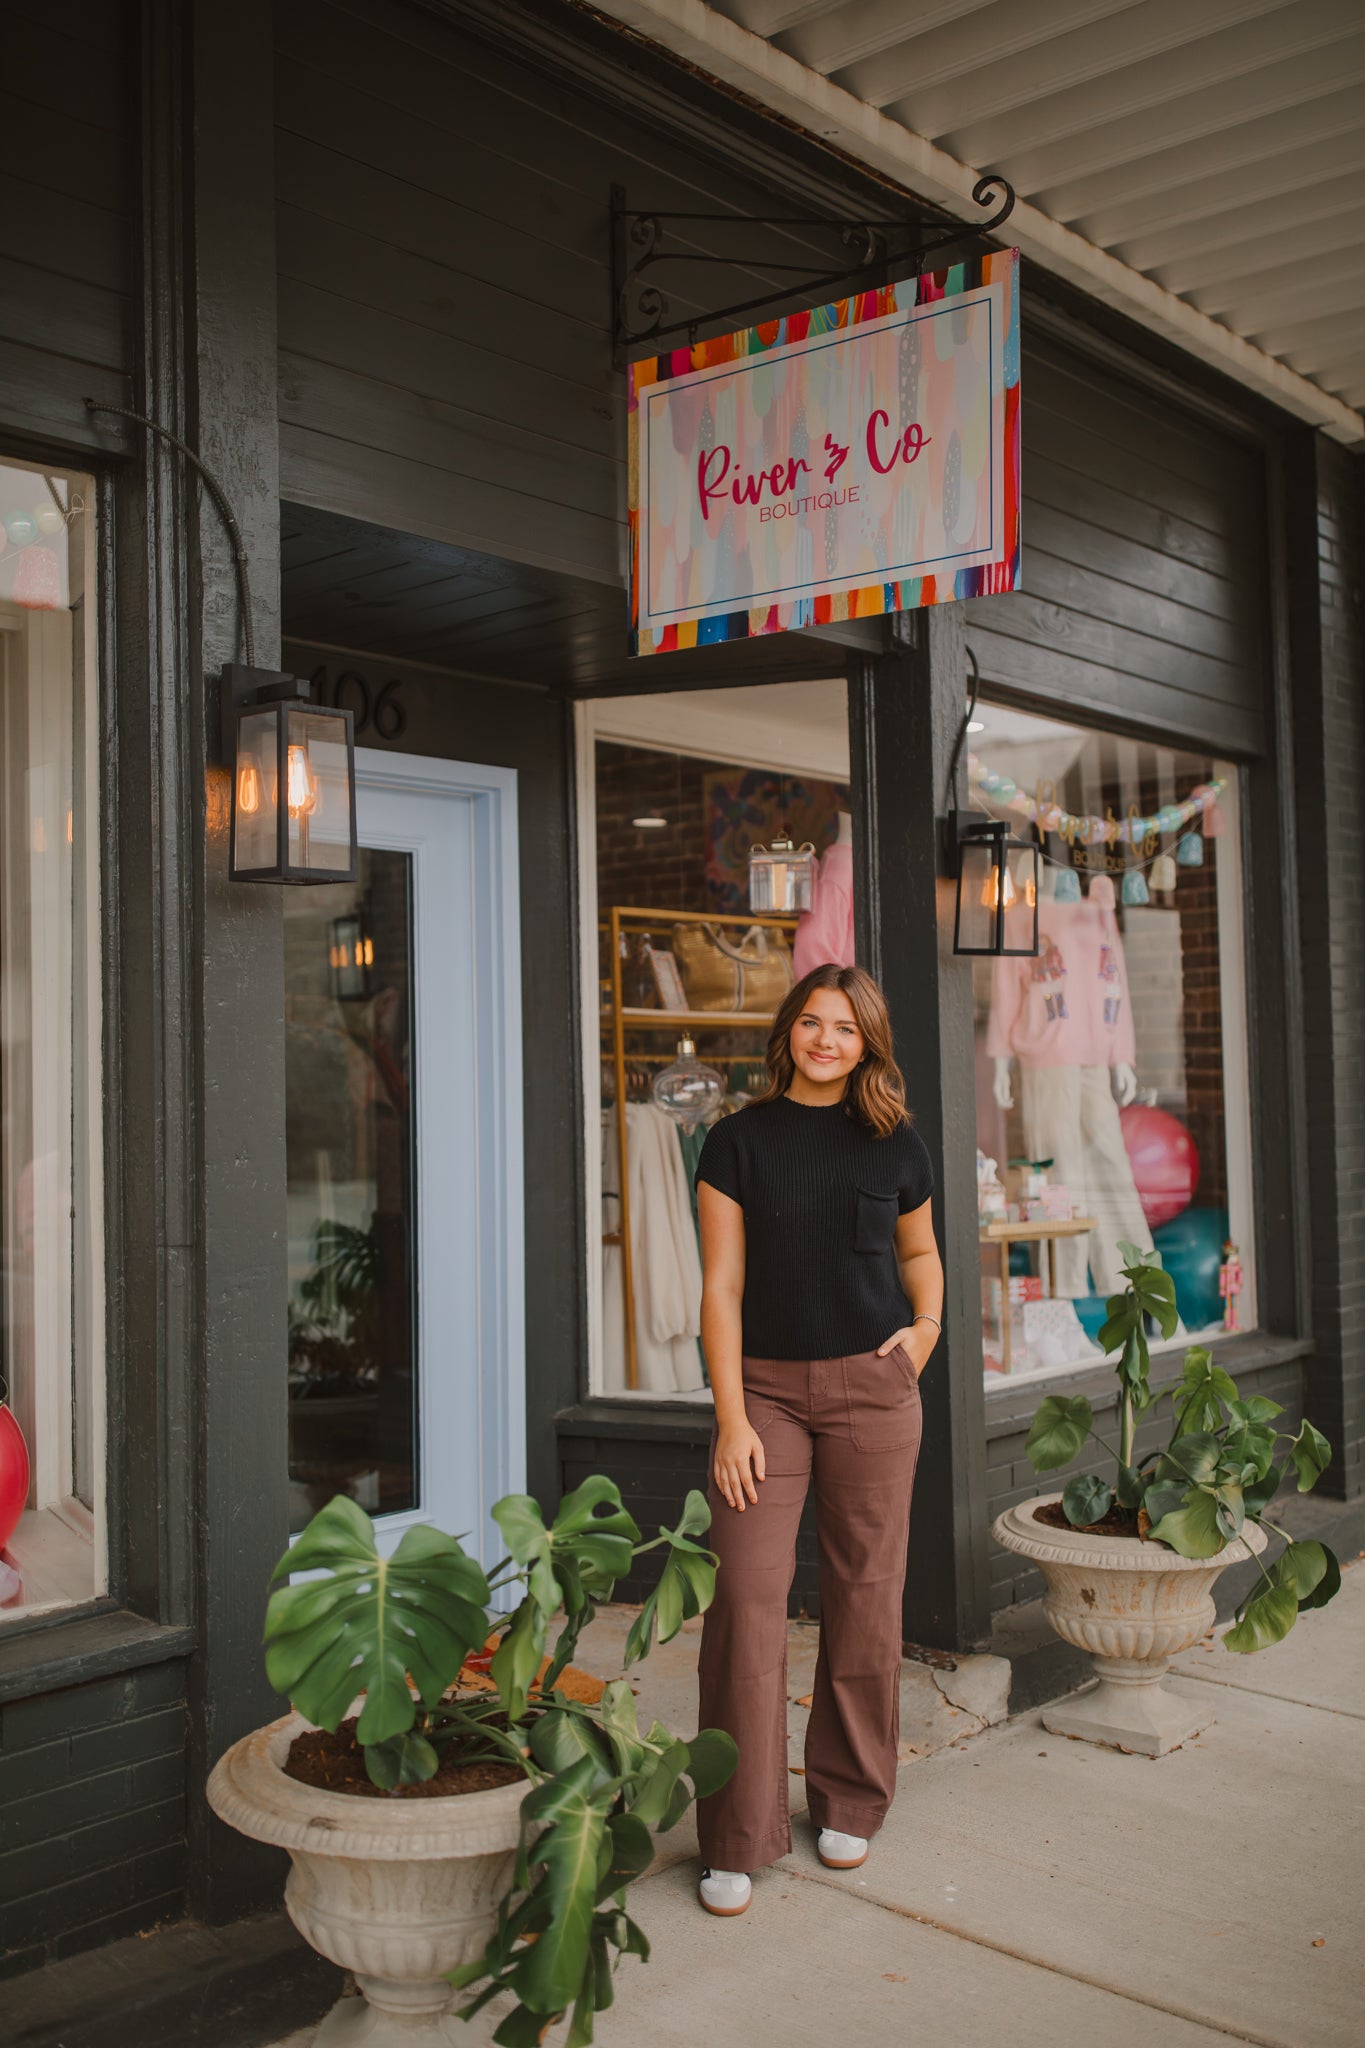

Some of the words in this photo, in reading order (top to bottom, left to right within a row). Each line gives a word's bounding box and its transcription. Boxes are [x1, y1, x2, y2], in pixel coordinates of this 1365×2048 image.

[698, 444, 813, 520] River
[823, 433, 850, 484] &
[866, 409, 932, 474] Co
[759, 485, 861, 523] BOUTIQUE
[309, 665, 408, 740] 106
